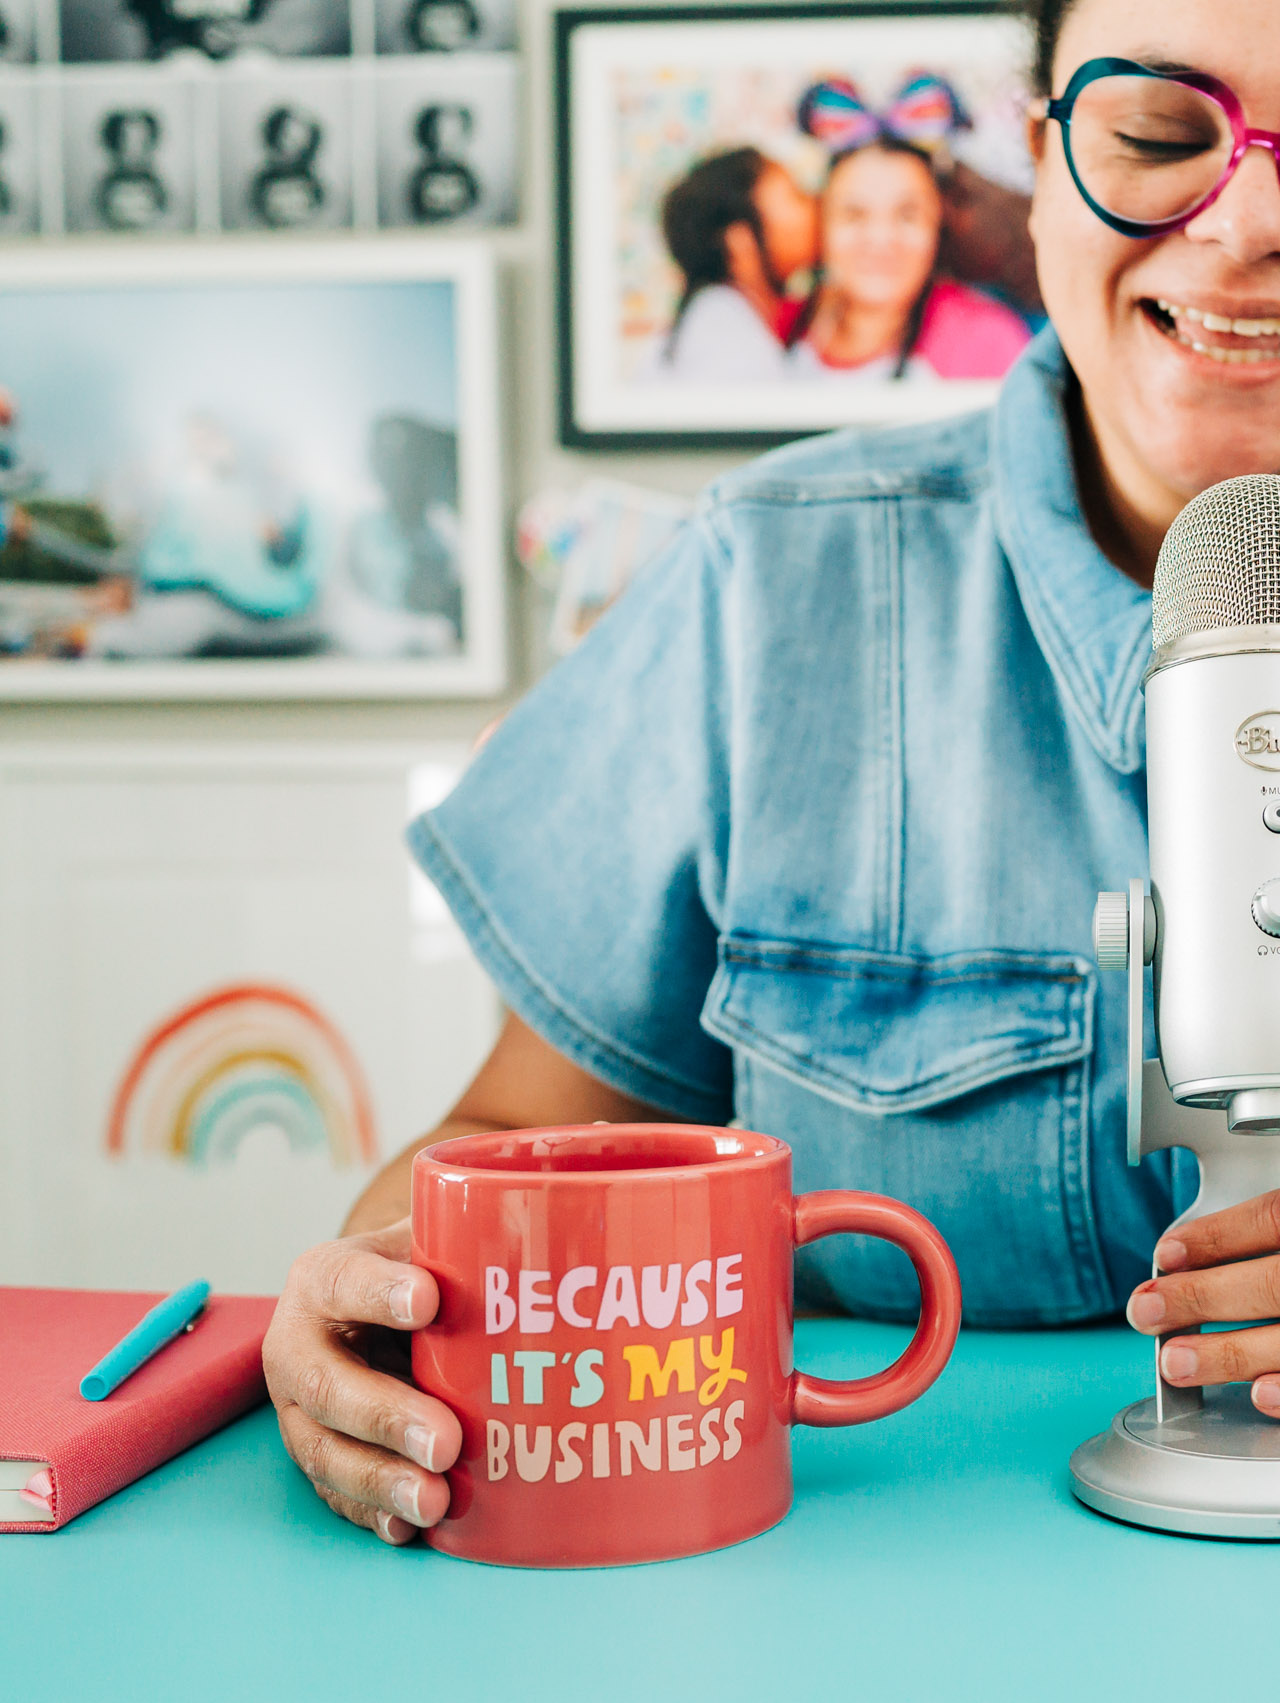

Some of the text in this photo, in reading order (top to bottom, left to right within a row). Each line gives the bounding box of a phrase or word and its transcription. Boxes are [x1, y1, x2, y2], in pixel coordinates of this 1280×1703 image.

[485, 1252, 744, 1335] BECAUSE
[490, 1348, 605, 1408] IT'S
[485, 1399, 745, 1484] BUSINESS
